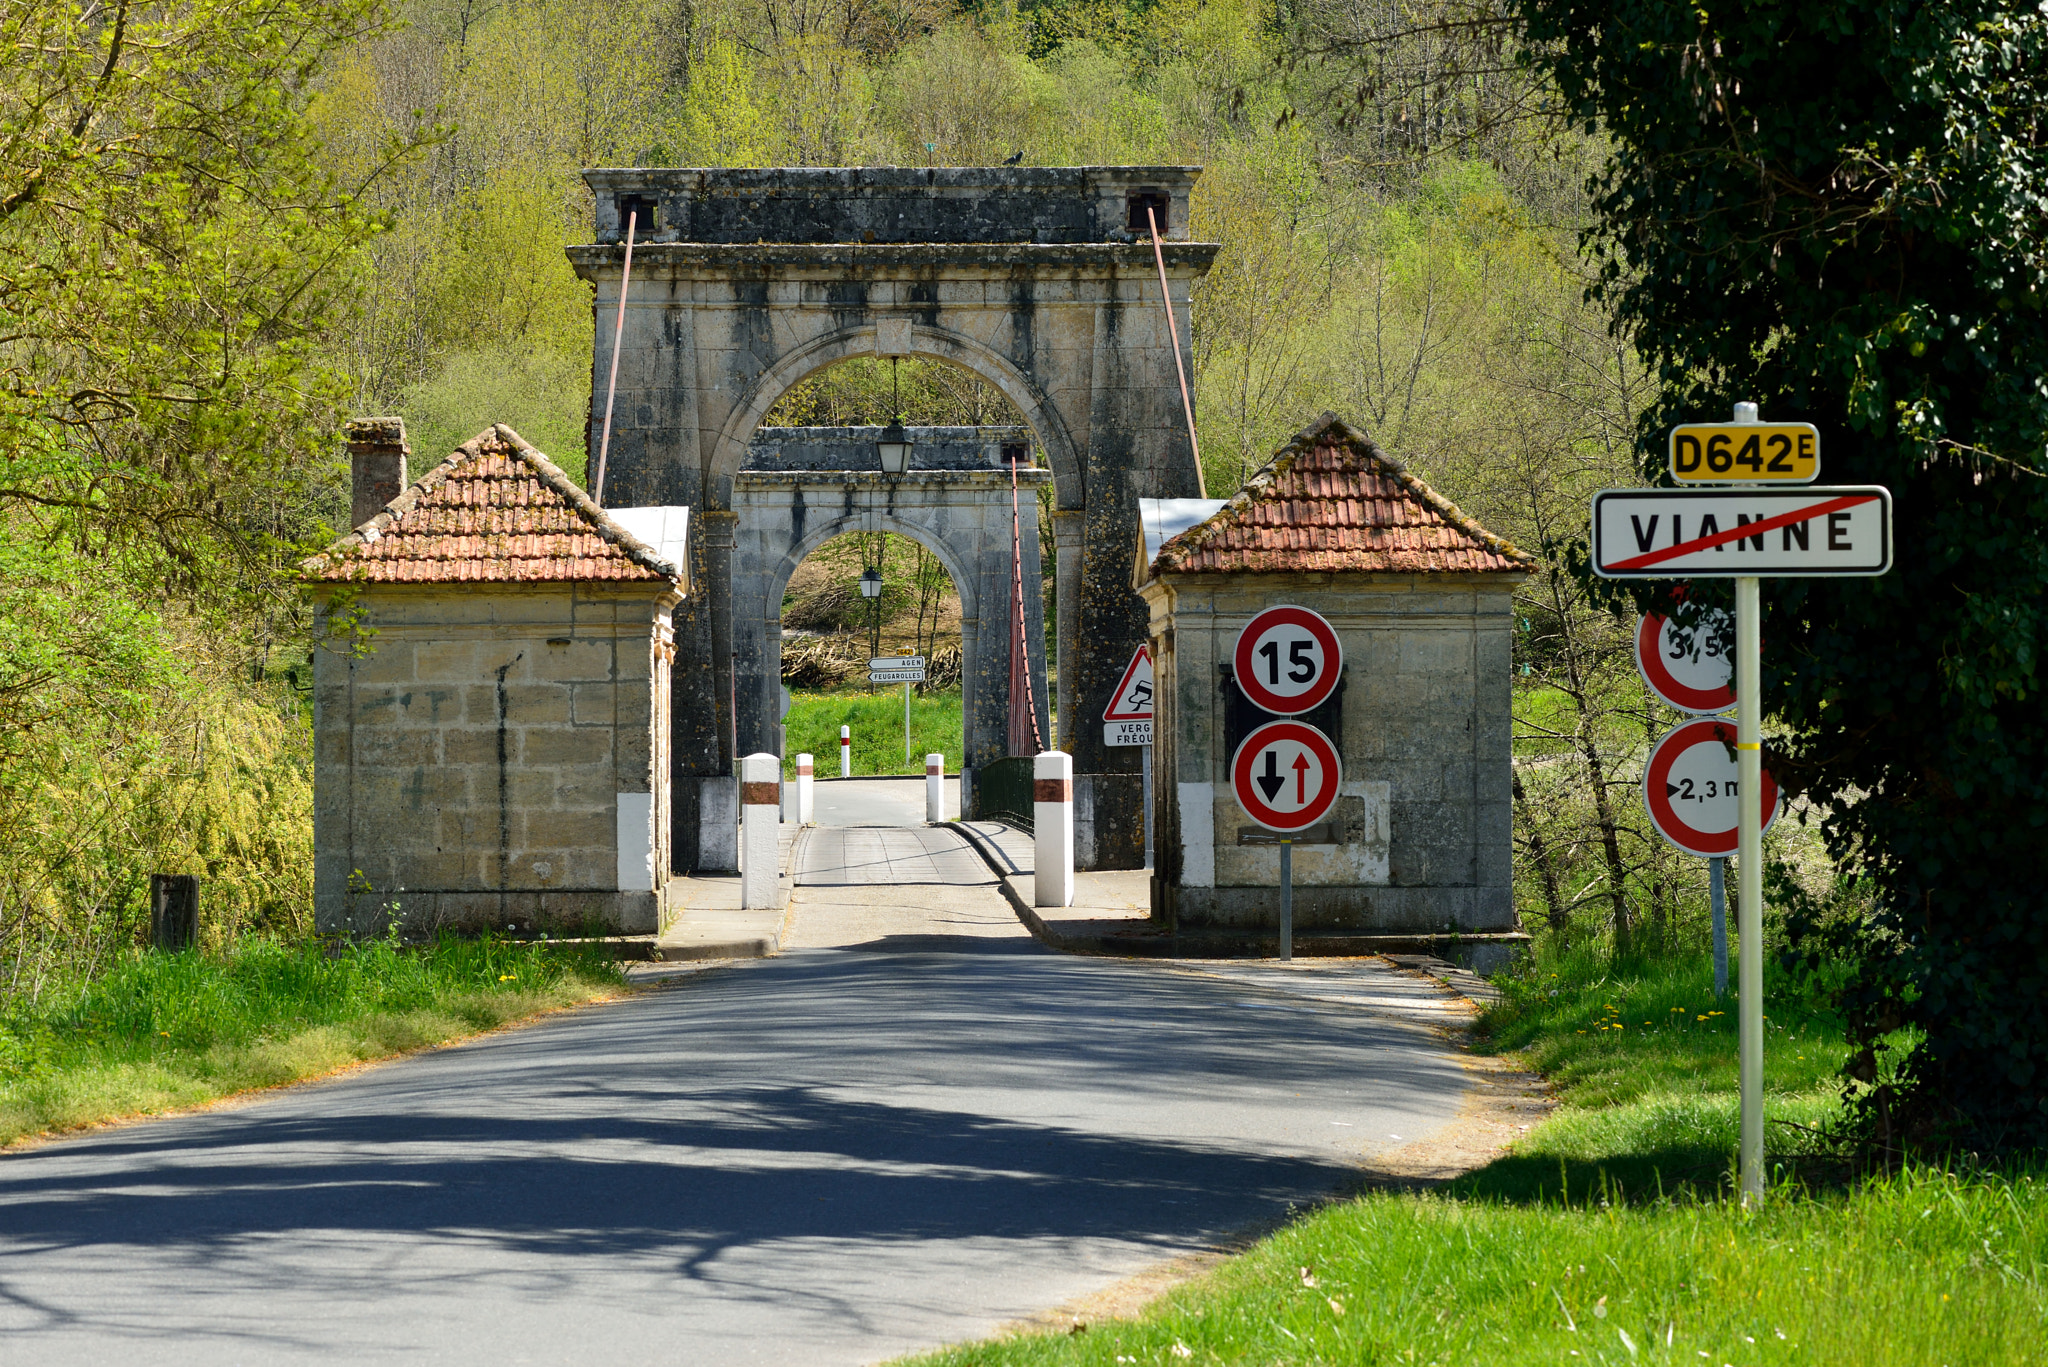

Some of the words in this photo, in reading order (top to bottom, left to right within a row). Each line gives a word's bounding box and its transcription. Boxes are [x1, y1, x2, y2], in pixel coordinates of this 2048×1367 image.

[1675, 434, 1814, 473] D642E
[1630, 512, 1853, 553] VIANNE
[874, 672, 921, 680] FEUGAROLLES
[1258, 640, 1316, 685] 15
[1120, 724, 1150, 733] VERG
[1679, 777, 1717, 803] 2,3
